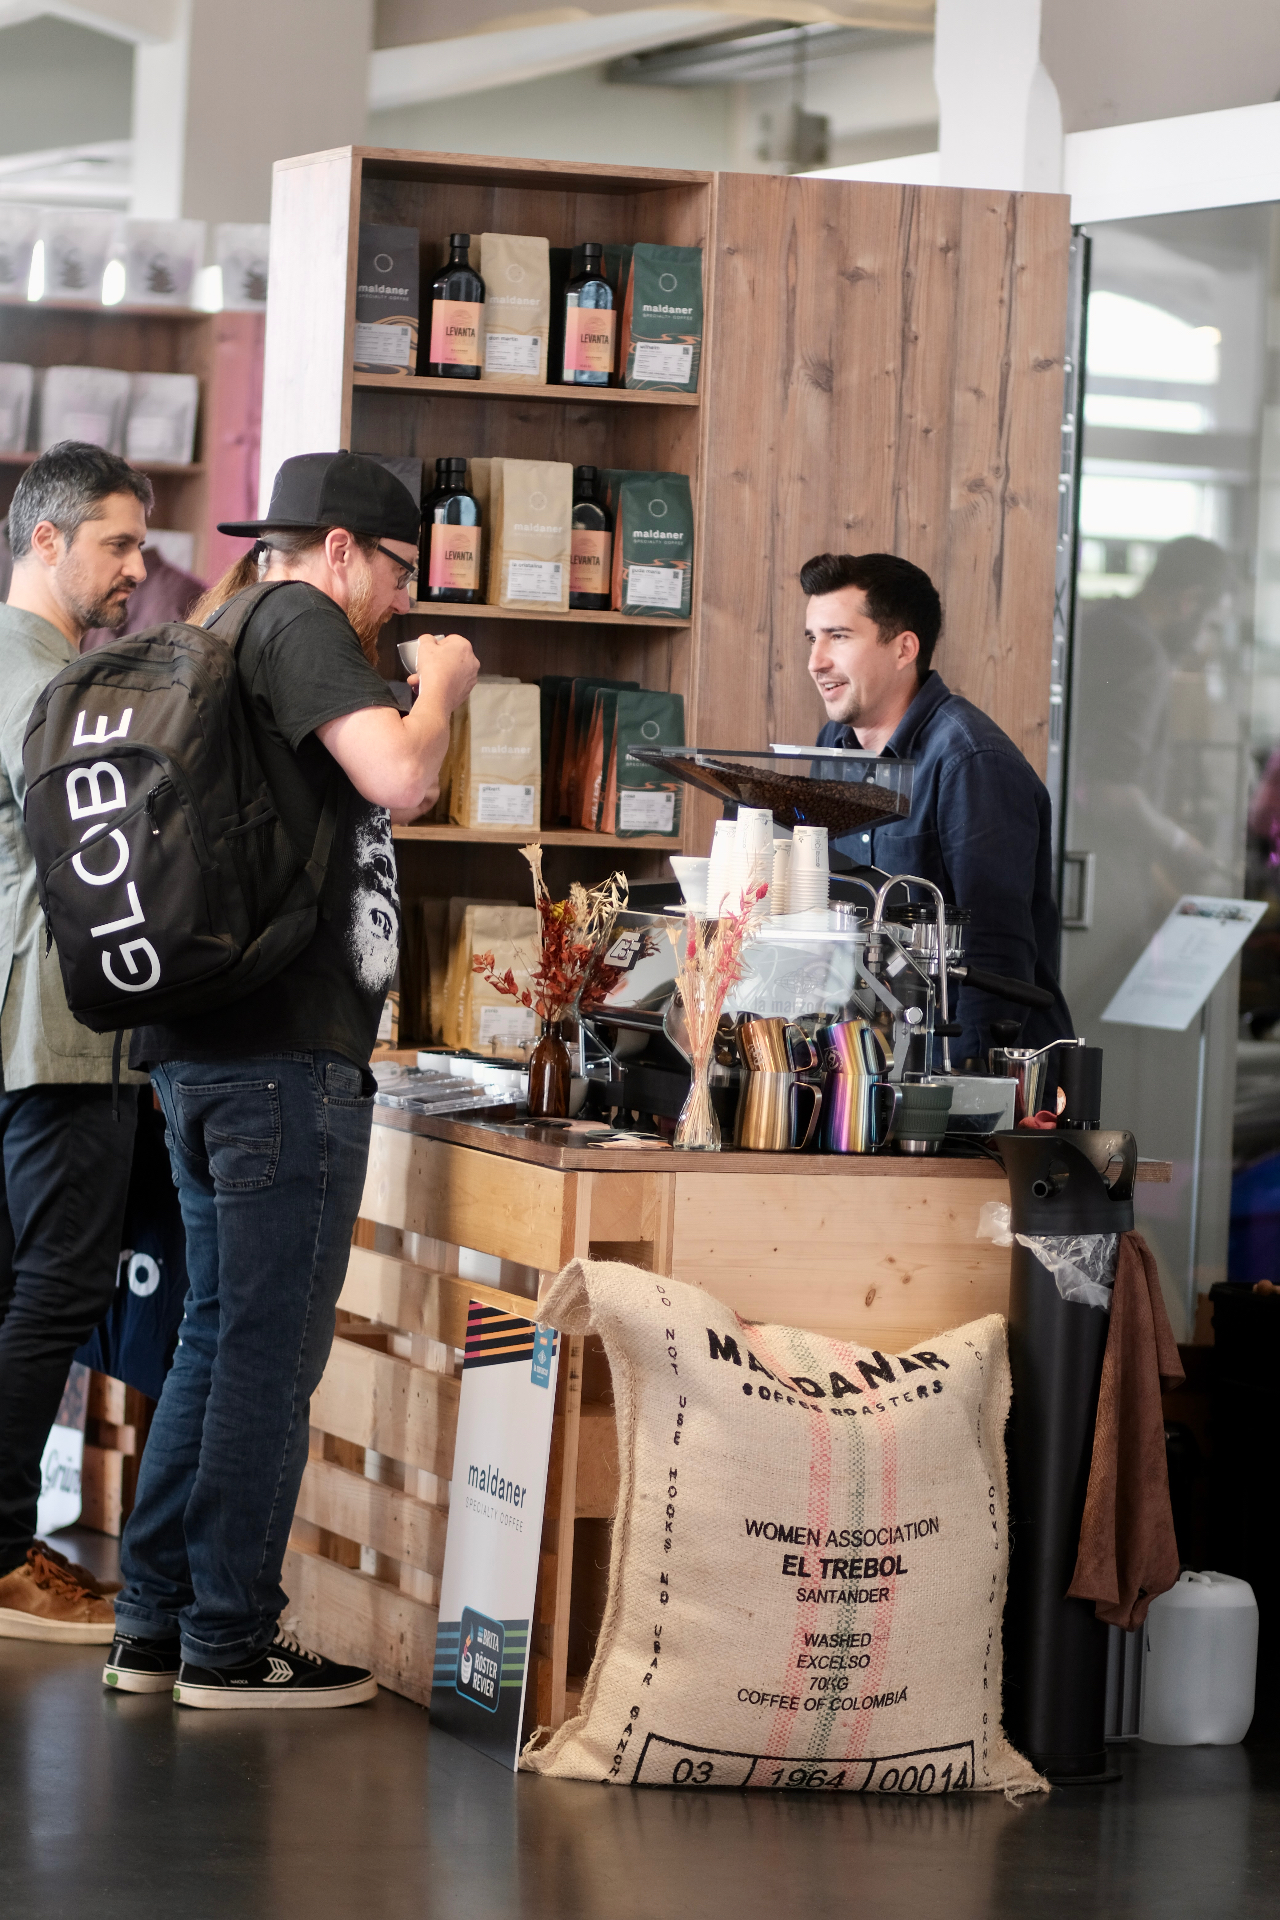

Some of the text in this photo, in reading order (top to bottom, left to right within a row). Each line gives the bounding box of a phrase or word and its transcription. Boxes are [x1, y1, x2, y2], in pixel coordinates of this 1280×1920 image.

[358, 284, 409, 295] maldaner
[489, 295, 540, 306] maldaner
[642, 304, 693, 314] maldaner
[445, 326, 476, 338] LEVANTA
[580, 333, 609, 344] LEVANTA
[514, 523, 562, 533] maldaner
[632, 529, 684, 539] maldaner
[445, 550, 474, 562] LEVANTA
[570, 555, 600, 566] LEVANTA
[481, 745, 532, 754] maldaner
[66, 707, 161, 993] GLOBE
[467, 1464, 527, 1509] maldaner
[465, 1496, 524, 1533] SPECIALTY COFFEE
[745, 1516, 940, 1548] WOMEN ASSOCIATION
[782, 1554, 908, 1580] EL TREBOL
[796, 1587, 890, 1604] SANTANDER
[482, 1628, 499, 1652] BRITA
[804, 1633, 872, 1648] WASHED
[474, 1651, 497, 1680] RÖSTER
[796, 1654, 871, 1669] EXCELSO
[472, 1672, 495, 1698] REVIER
[809, 1677, 849, 1691] 70KG
[737, 1686, 908, 1711] COFFEE OF COLOMBIA
[672, 1757, 968, 1793] 03 1964 00014
